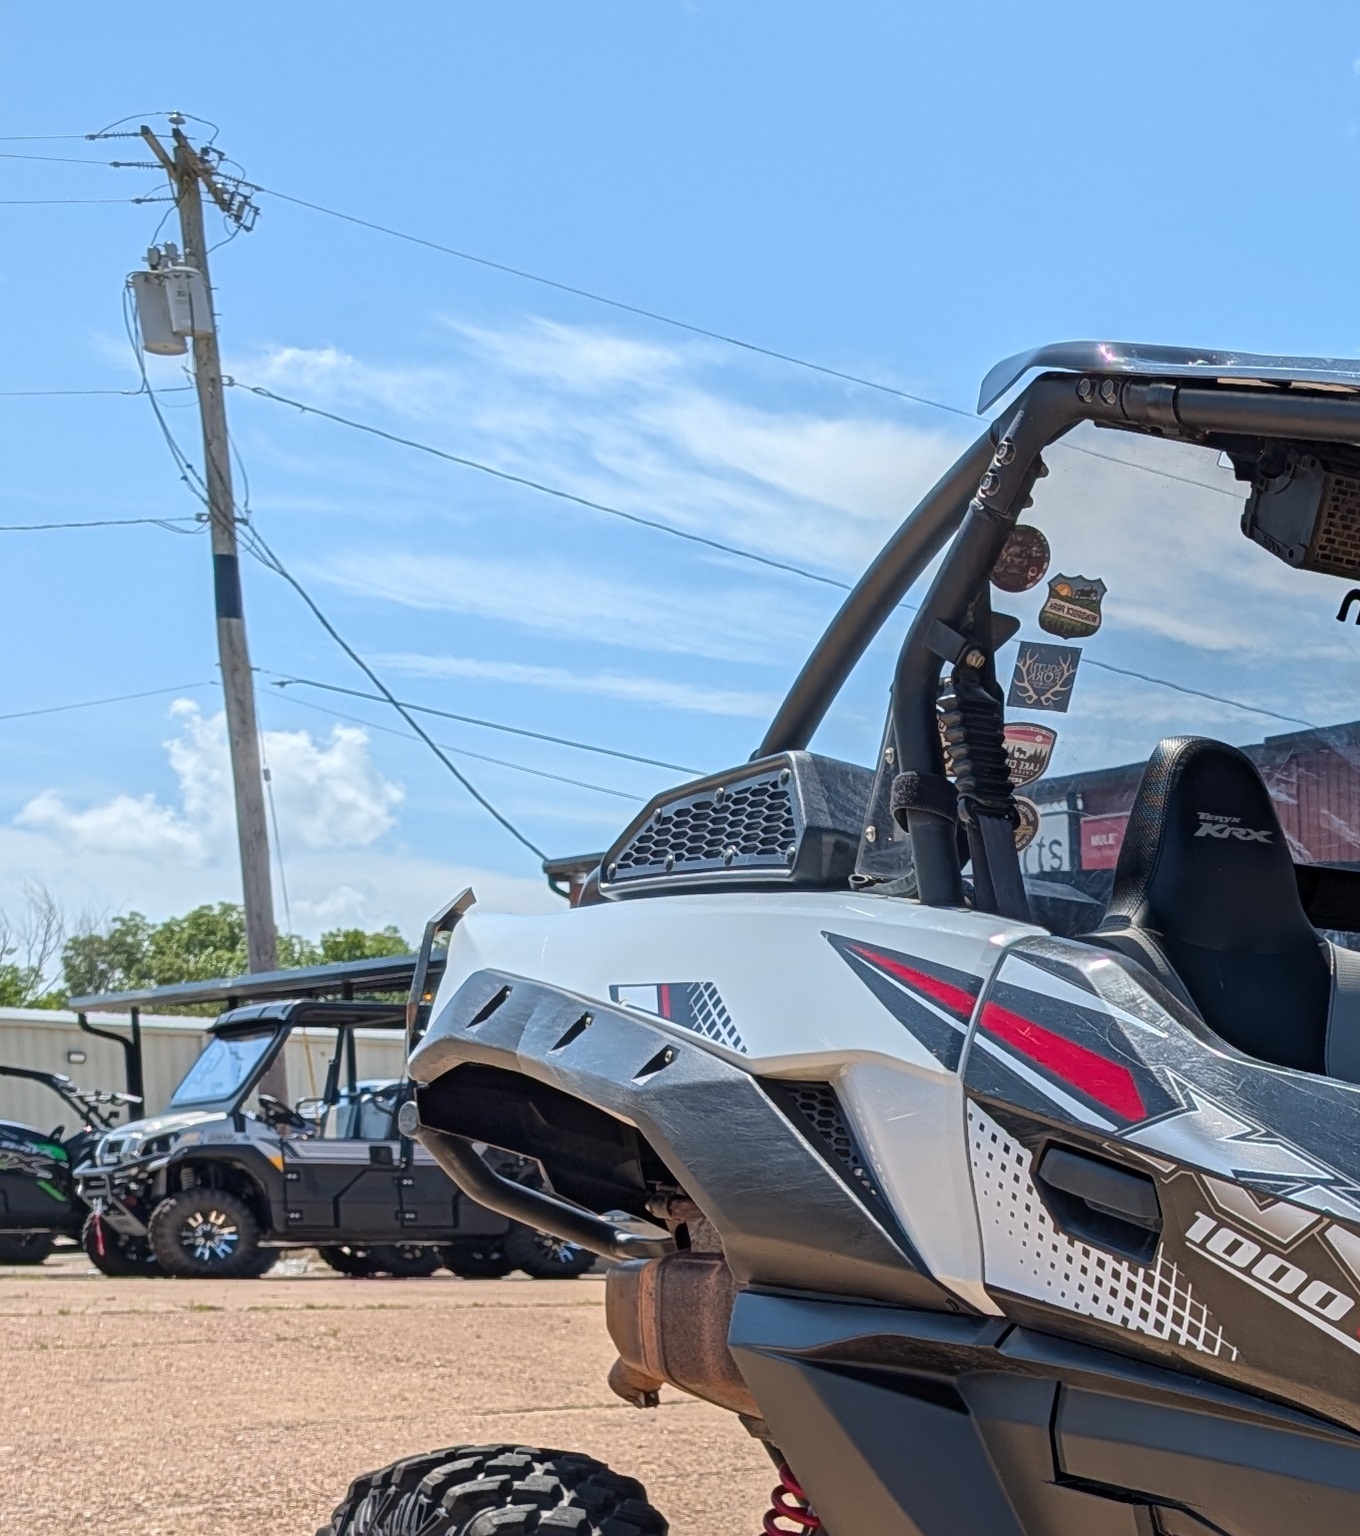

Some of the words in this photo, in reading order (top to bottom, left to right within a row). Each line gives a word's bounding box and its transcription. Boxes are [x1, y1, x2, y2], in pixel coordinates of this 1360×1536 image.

[1090, 833, 1117, 846] MULE
[1194, 822, 1273, 844] KRX
[1185, 1211, 1356, 1322] 1000
